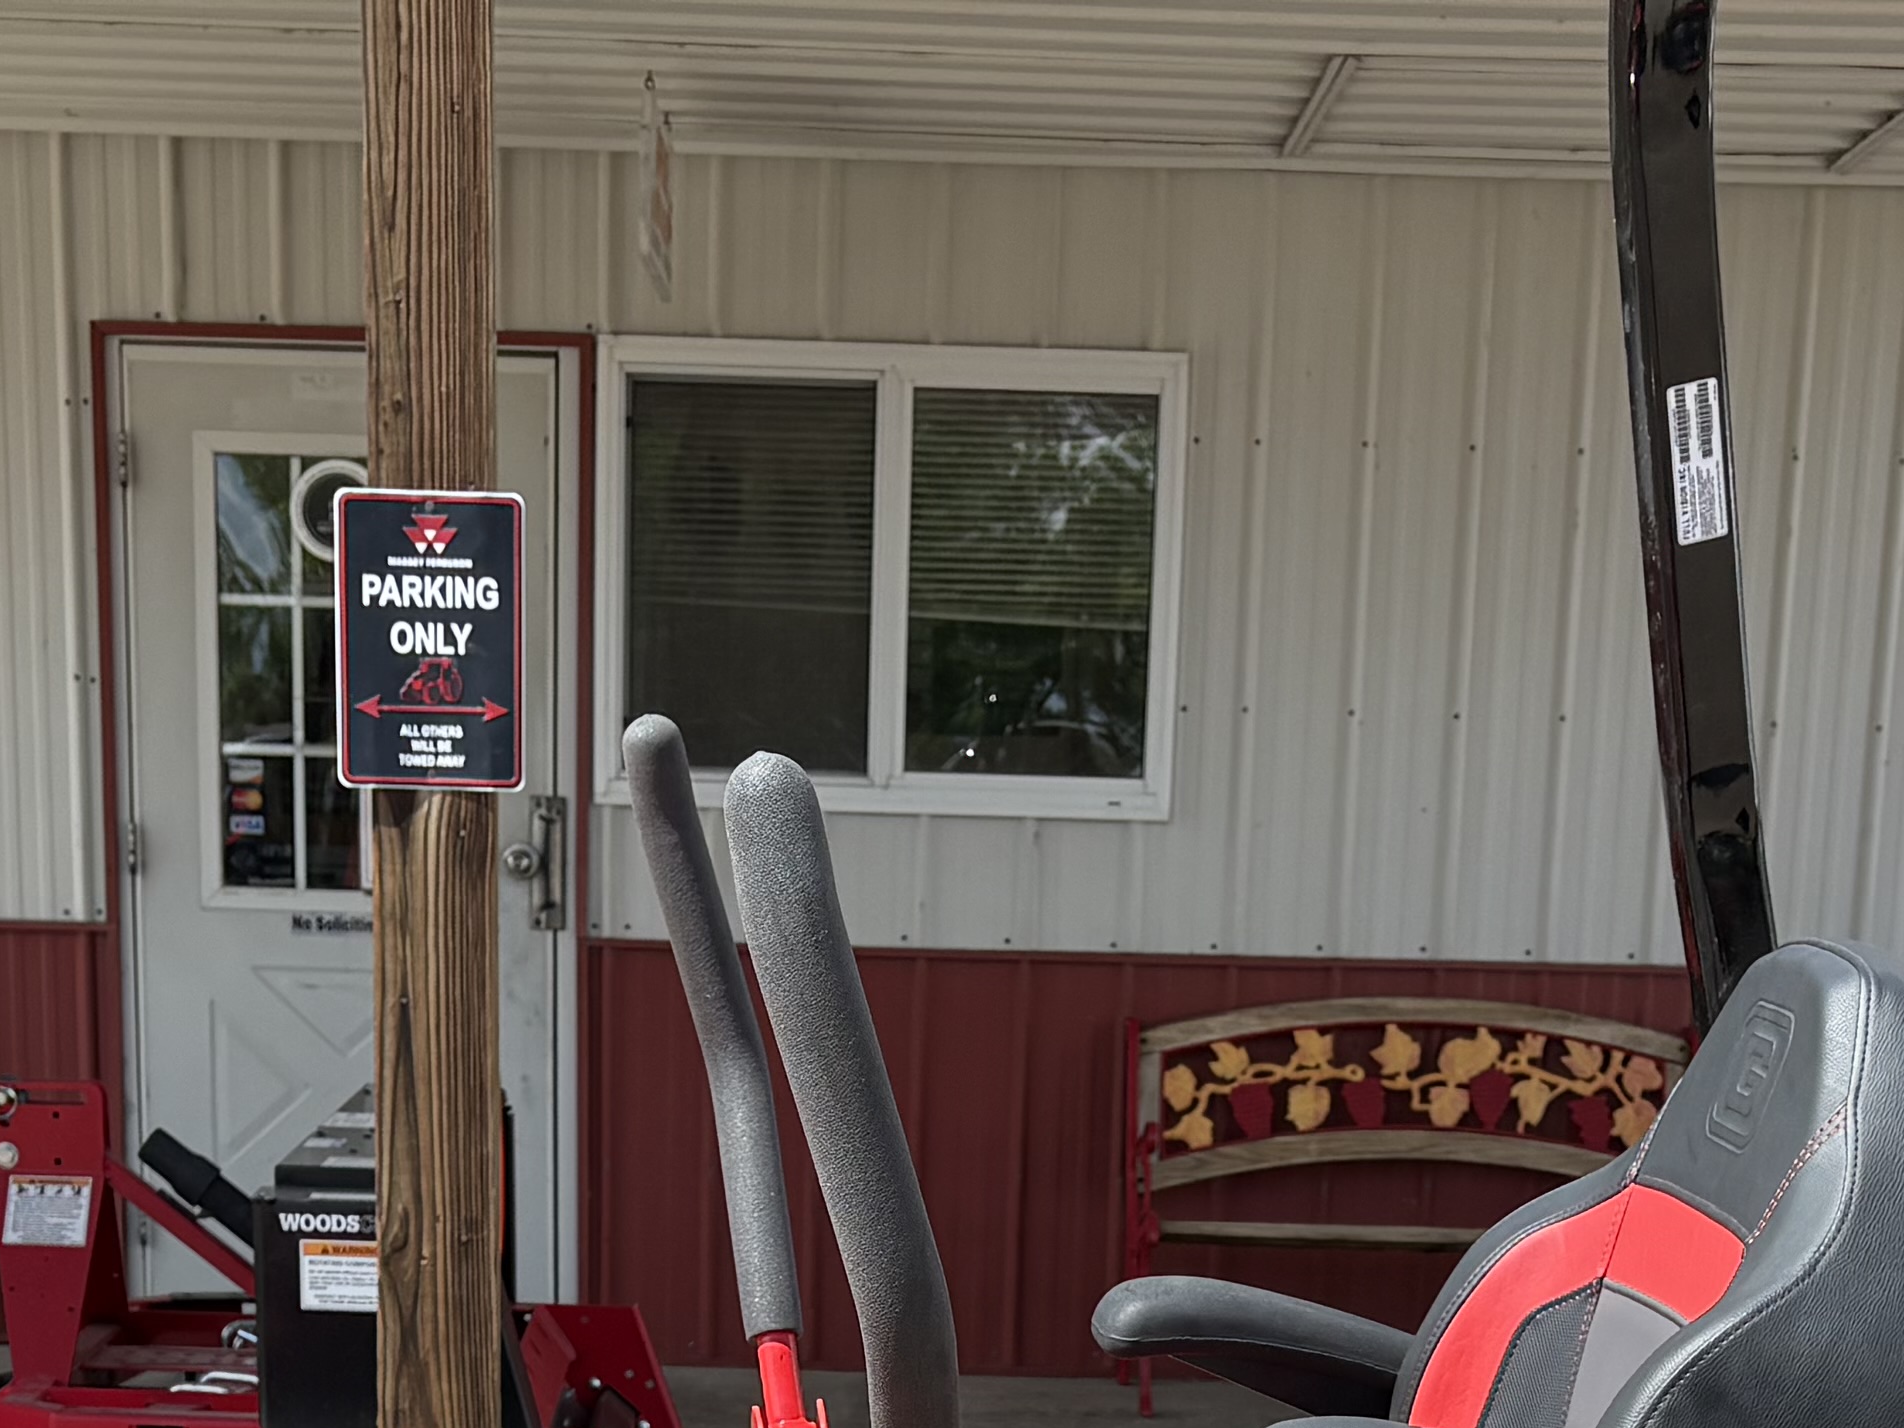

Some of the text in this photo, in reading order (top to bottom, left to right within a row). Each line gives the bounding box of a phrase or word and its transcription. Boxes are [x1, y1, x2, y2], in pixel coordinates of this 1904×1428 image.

[361, 573, 500, 610] PARKING
[390, 621, 473, 656] ONLY
[399, 723, 464, 739] ALL OTHERS
[410, 739, 436, 753] WILL
[398, 753, 435, 767] TOWED
[279, 1213, 361, 1233] WOODS
